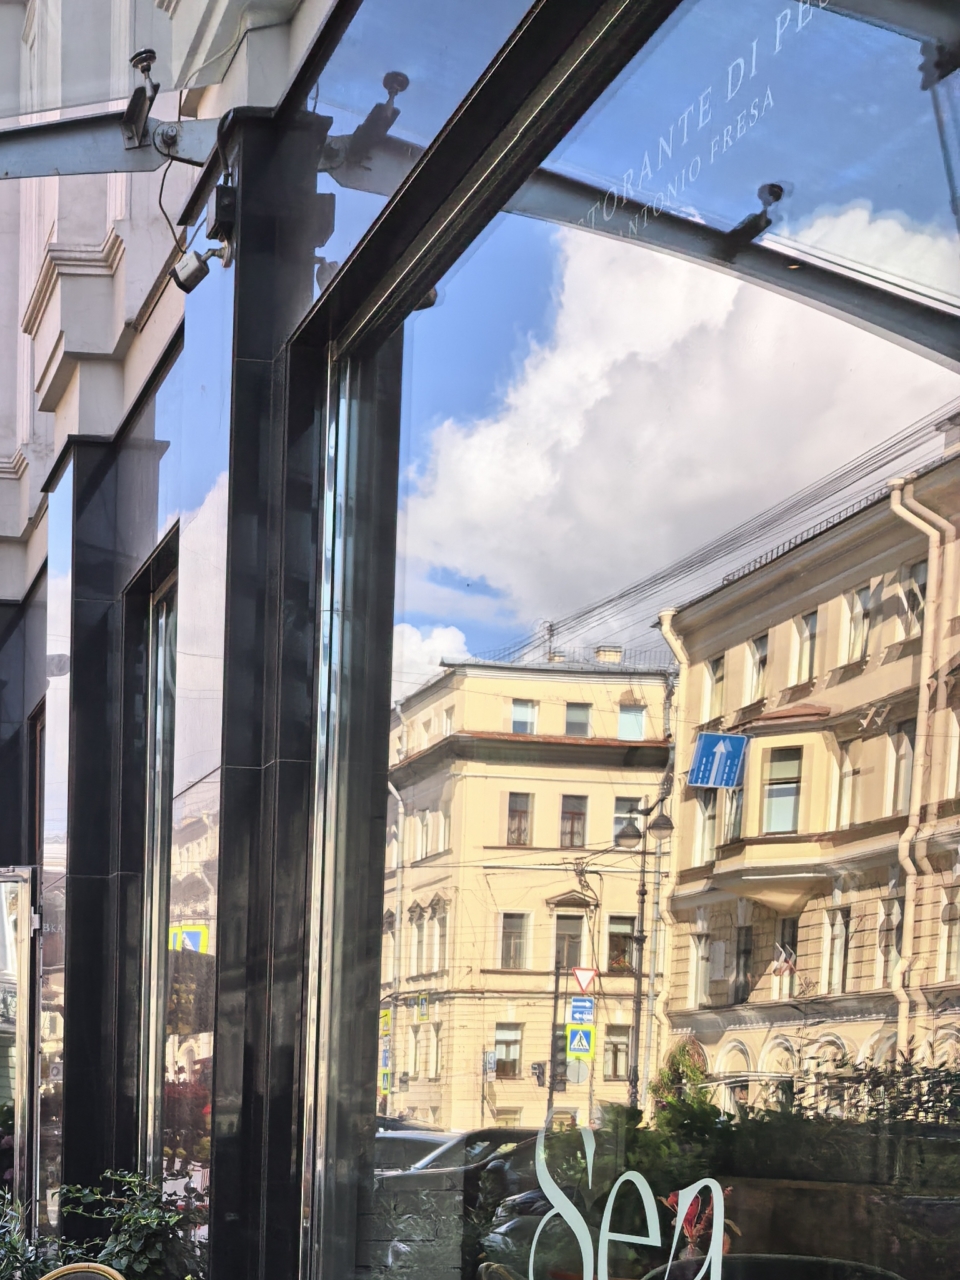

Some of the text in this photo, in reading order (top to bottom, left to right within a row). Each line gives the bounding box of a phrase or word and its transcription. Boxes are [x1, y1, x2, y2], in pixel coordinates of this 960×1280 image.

[578, 86, 713, 230] TORANTE
[726, 38, 759, 103] DI
[620, 85, 775, 239] NTONIO FRESA
